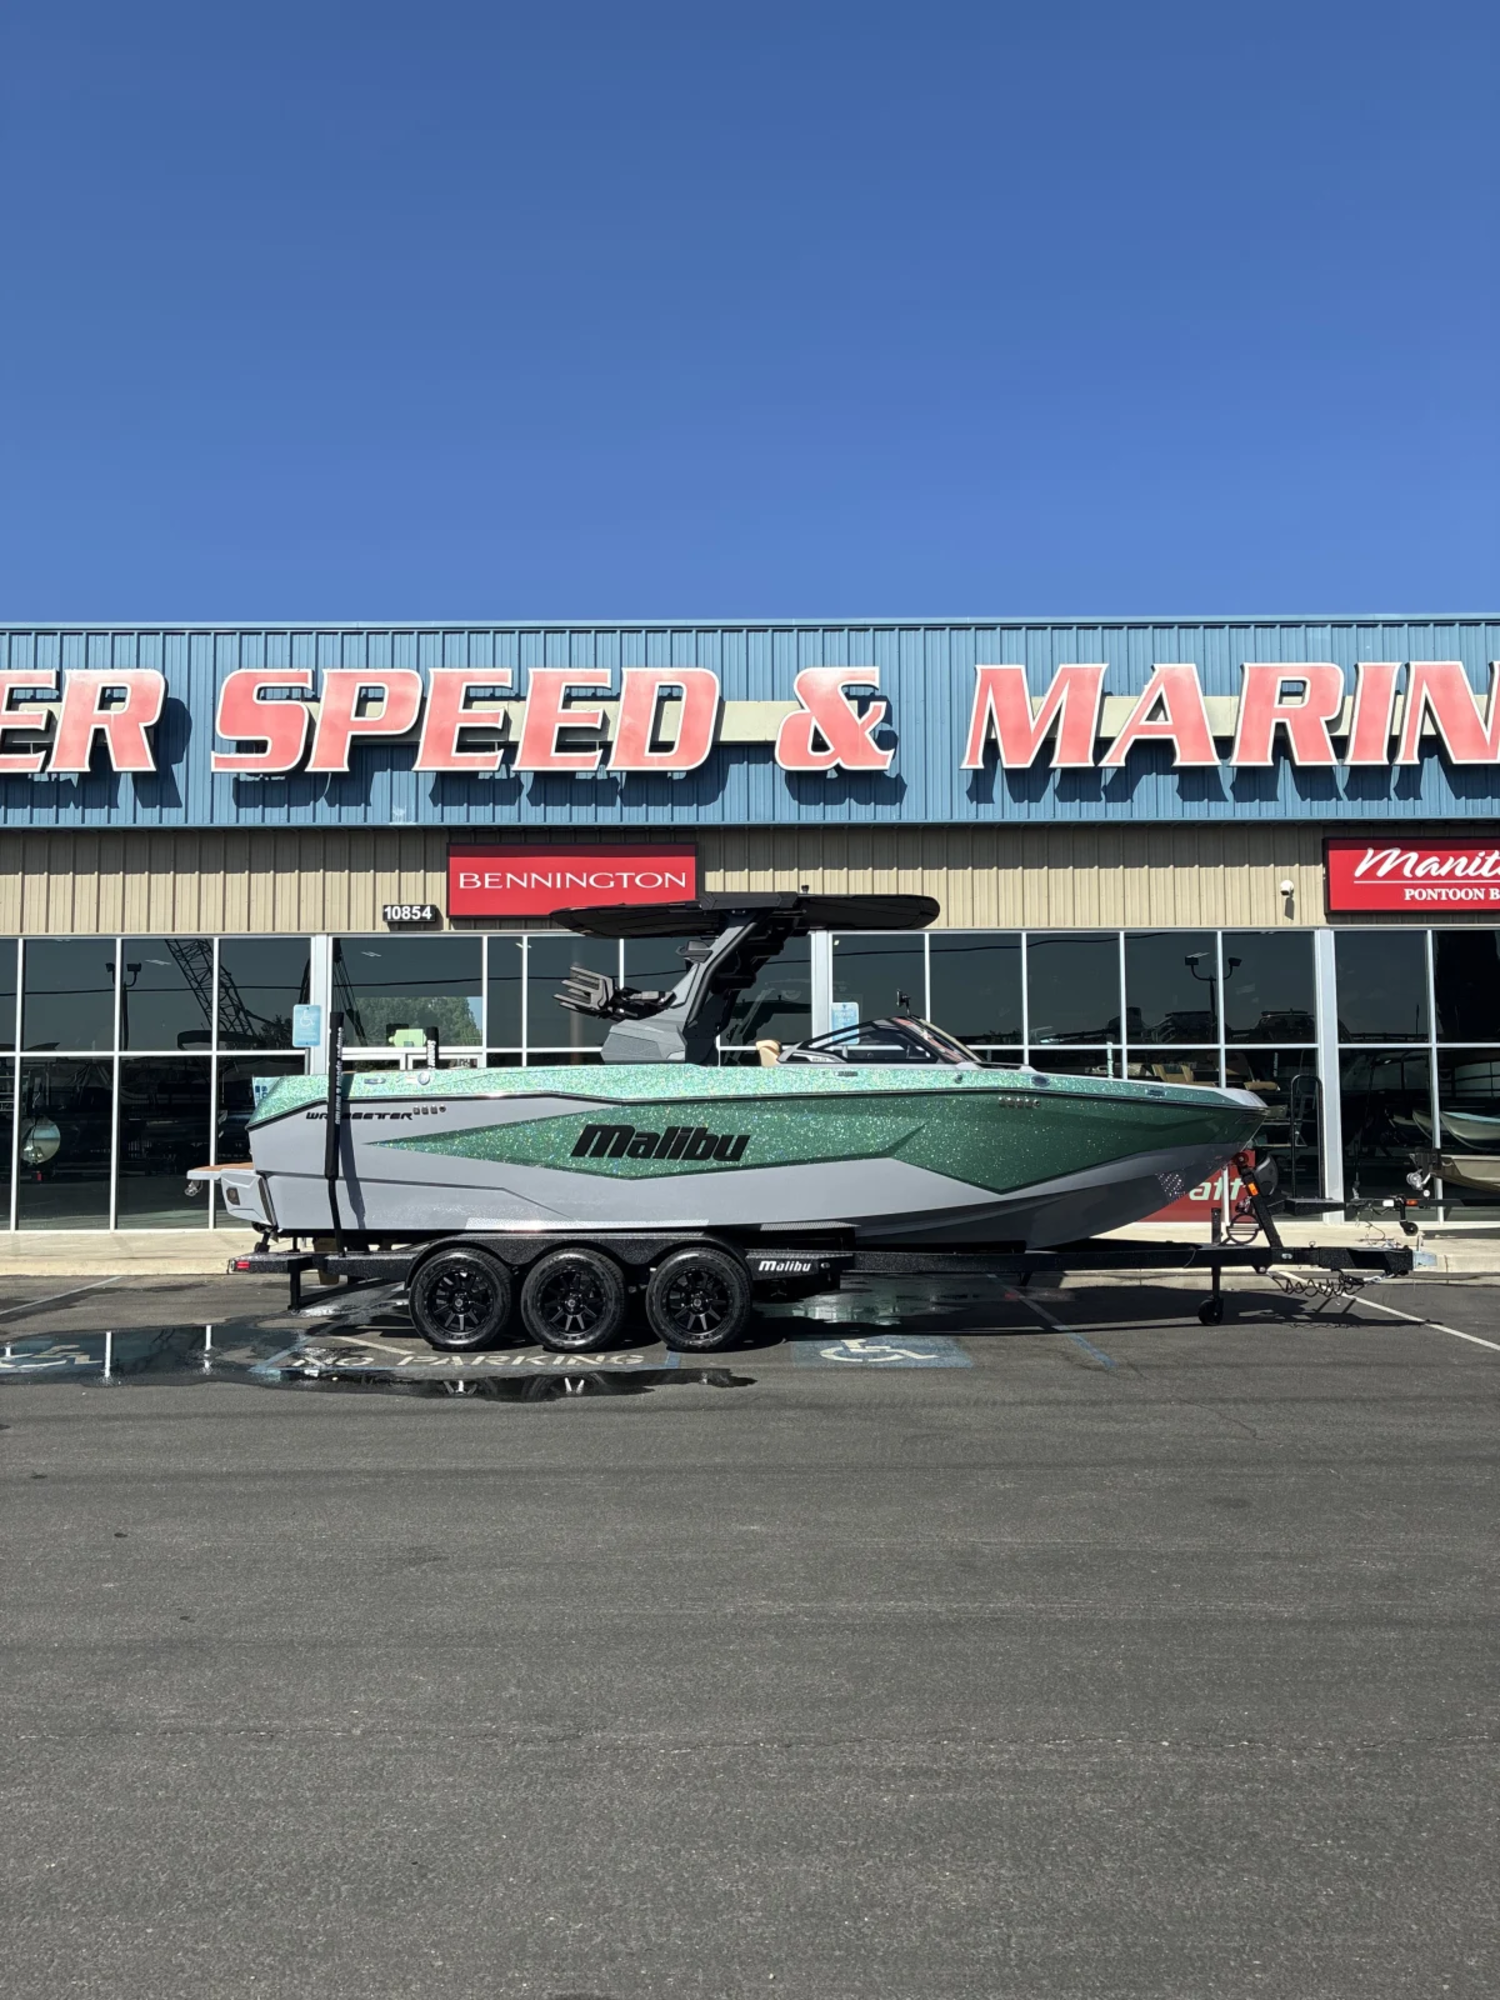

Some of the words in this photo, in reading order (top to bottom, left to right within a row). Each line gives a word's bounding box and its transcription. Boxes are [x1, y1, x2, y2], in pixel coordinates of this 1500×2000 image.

[0, 669, 165, 771] ER
[211, 668, 718, 772] SPEED
[775, 667, 895, 770] &
[960, 661, 1500, 769] MARIN
[459, 872, 687, 889] BENNINGTON
[1404, 888, 1485, 900] PONTOON
[384, 905, 432, 920] 10854
[570, 1124, 750, 1161] Malibu
[758, 1260, 811, 1272] Malibu
[397, 1355, 645, 1366] PARKING
